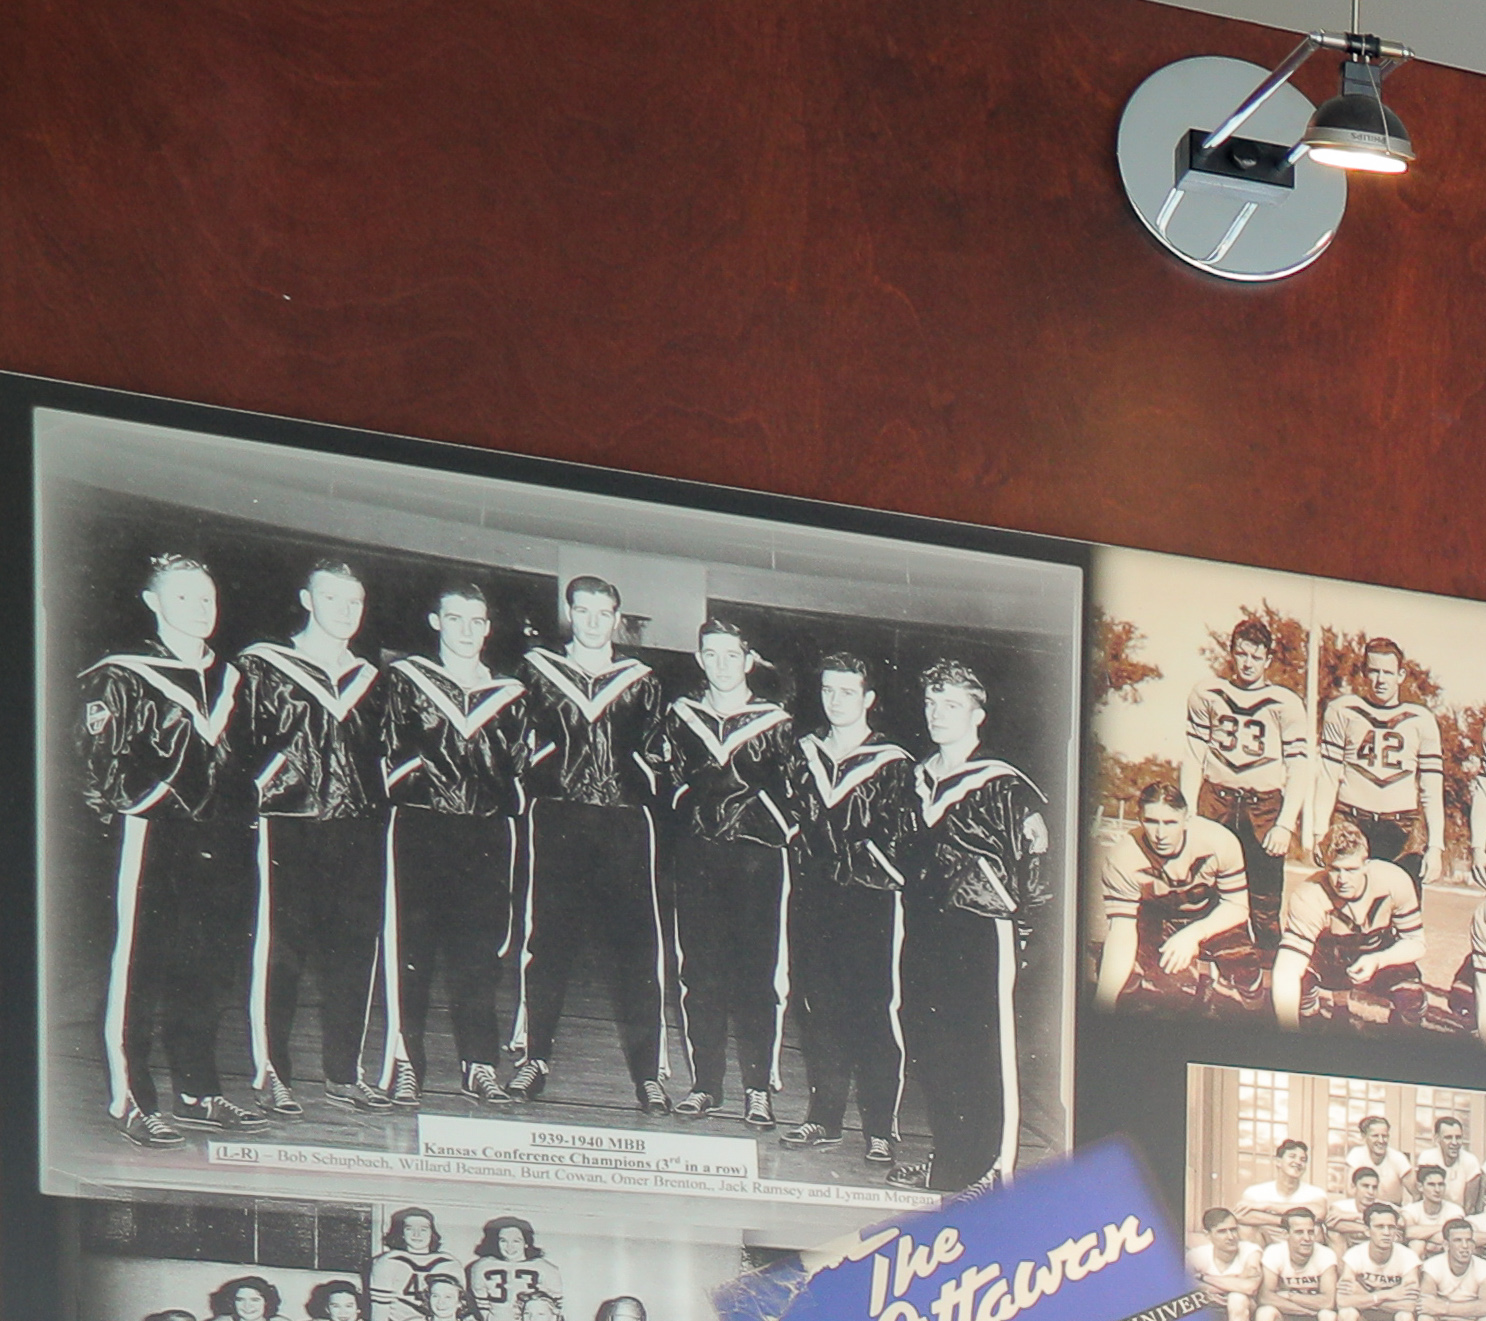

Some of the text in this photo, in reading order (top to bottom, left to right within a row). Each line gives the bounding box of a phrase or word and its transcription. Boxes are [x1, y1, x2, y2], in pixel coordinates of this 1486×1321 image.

[1218, 714, 1266, 757] 33
[1356, 728, 1405, 768] 42
[425, 1143, 748, 1177] Kansas Conference Champions (3rd in a row)
[532, 1132, 645, 1151] 1939-1940 MBB
[216, 1147, 934, 1208] (L-R) Bob Schupbach, Willard Beaman, Burt Cowan, Omer Brenton,, Jack Ramsey and Lyman Morgan
[857, 1225, 965, 1319] The
